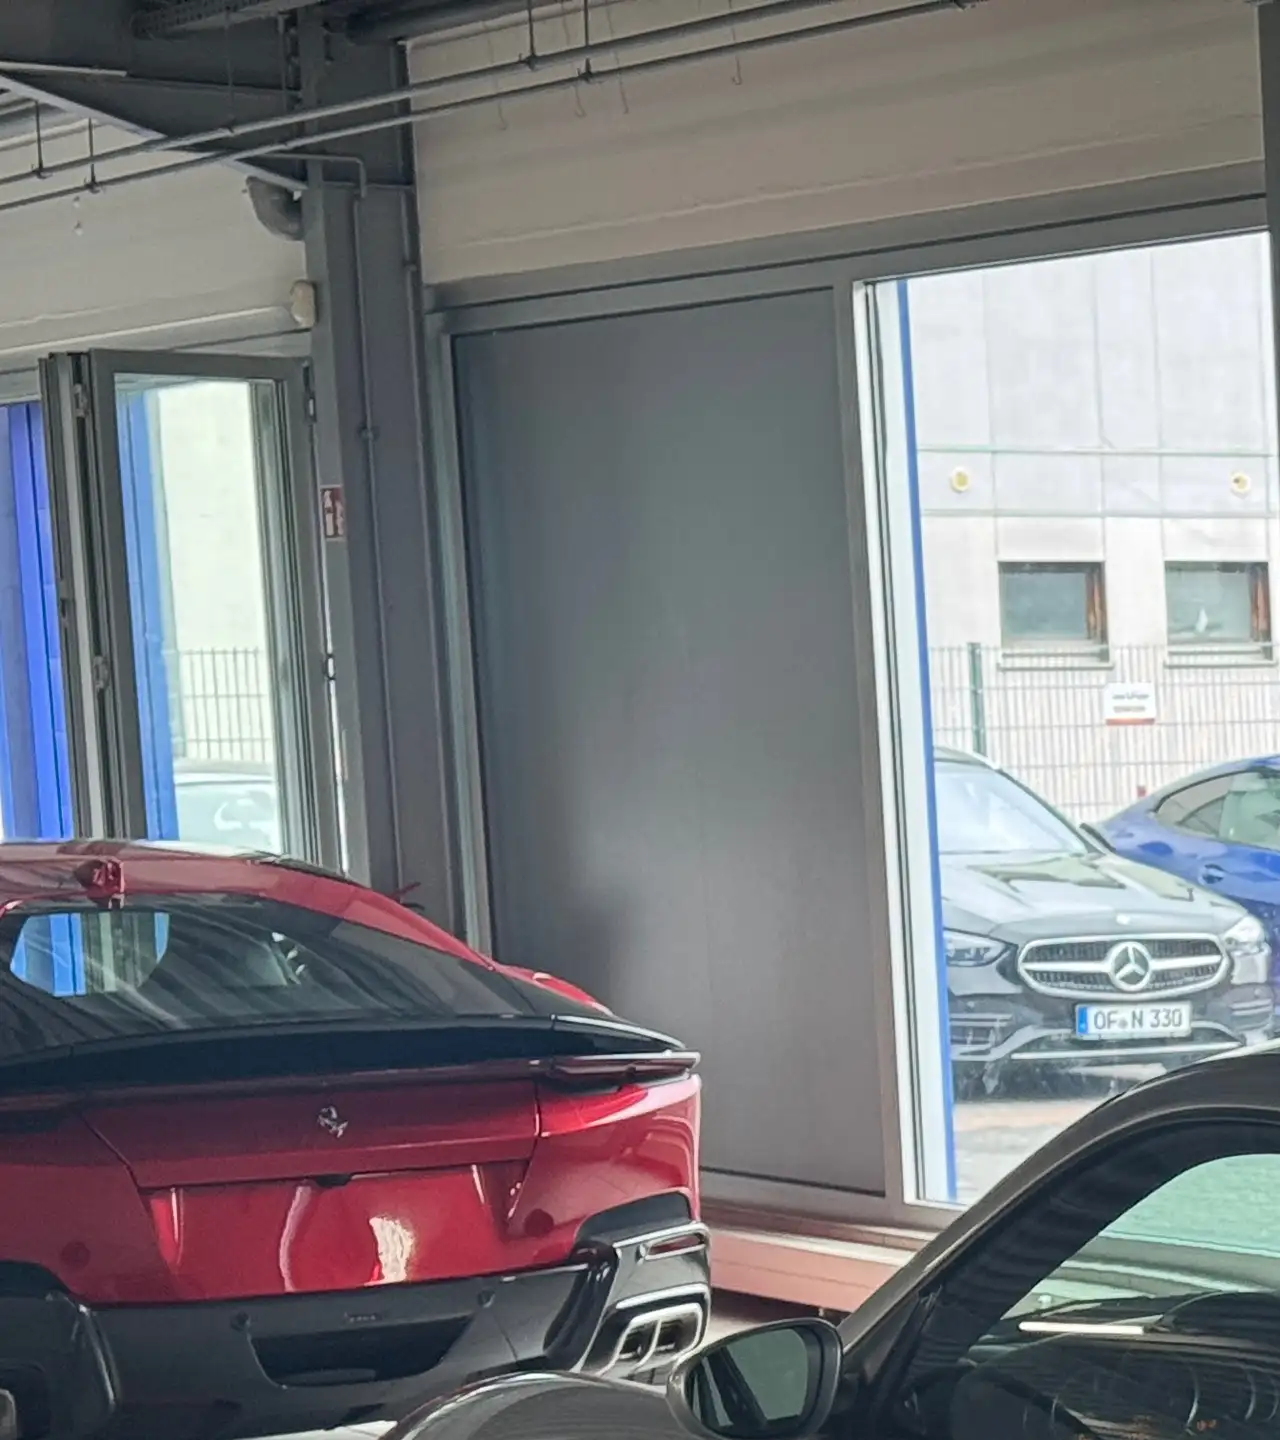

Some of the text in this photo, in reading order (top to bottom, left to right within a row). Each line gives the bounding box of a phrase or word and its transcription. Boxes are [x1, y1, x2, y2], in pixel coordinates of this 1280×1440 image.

[1093, 1007, 1183, 1030] OF N 330
